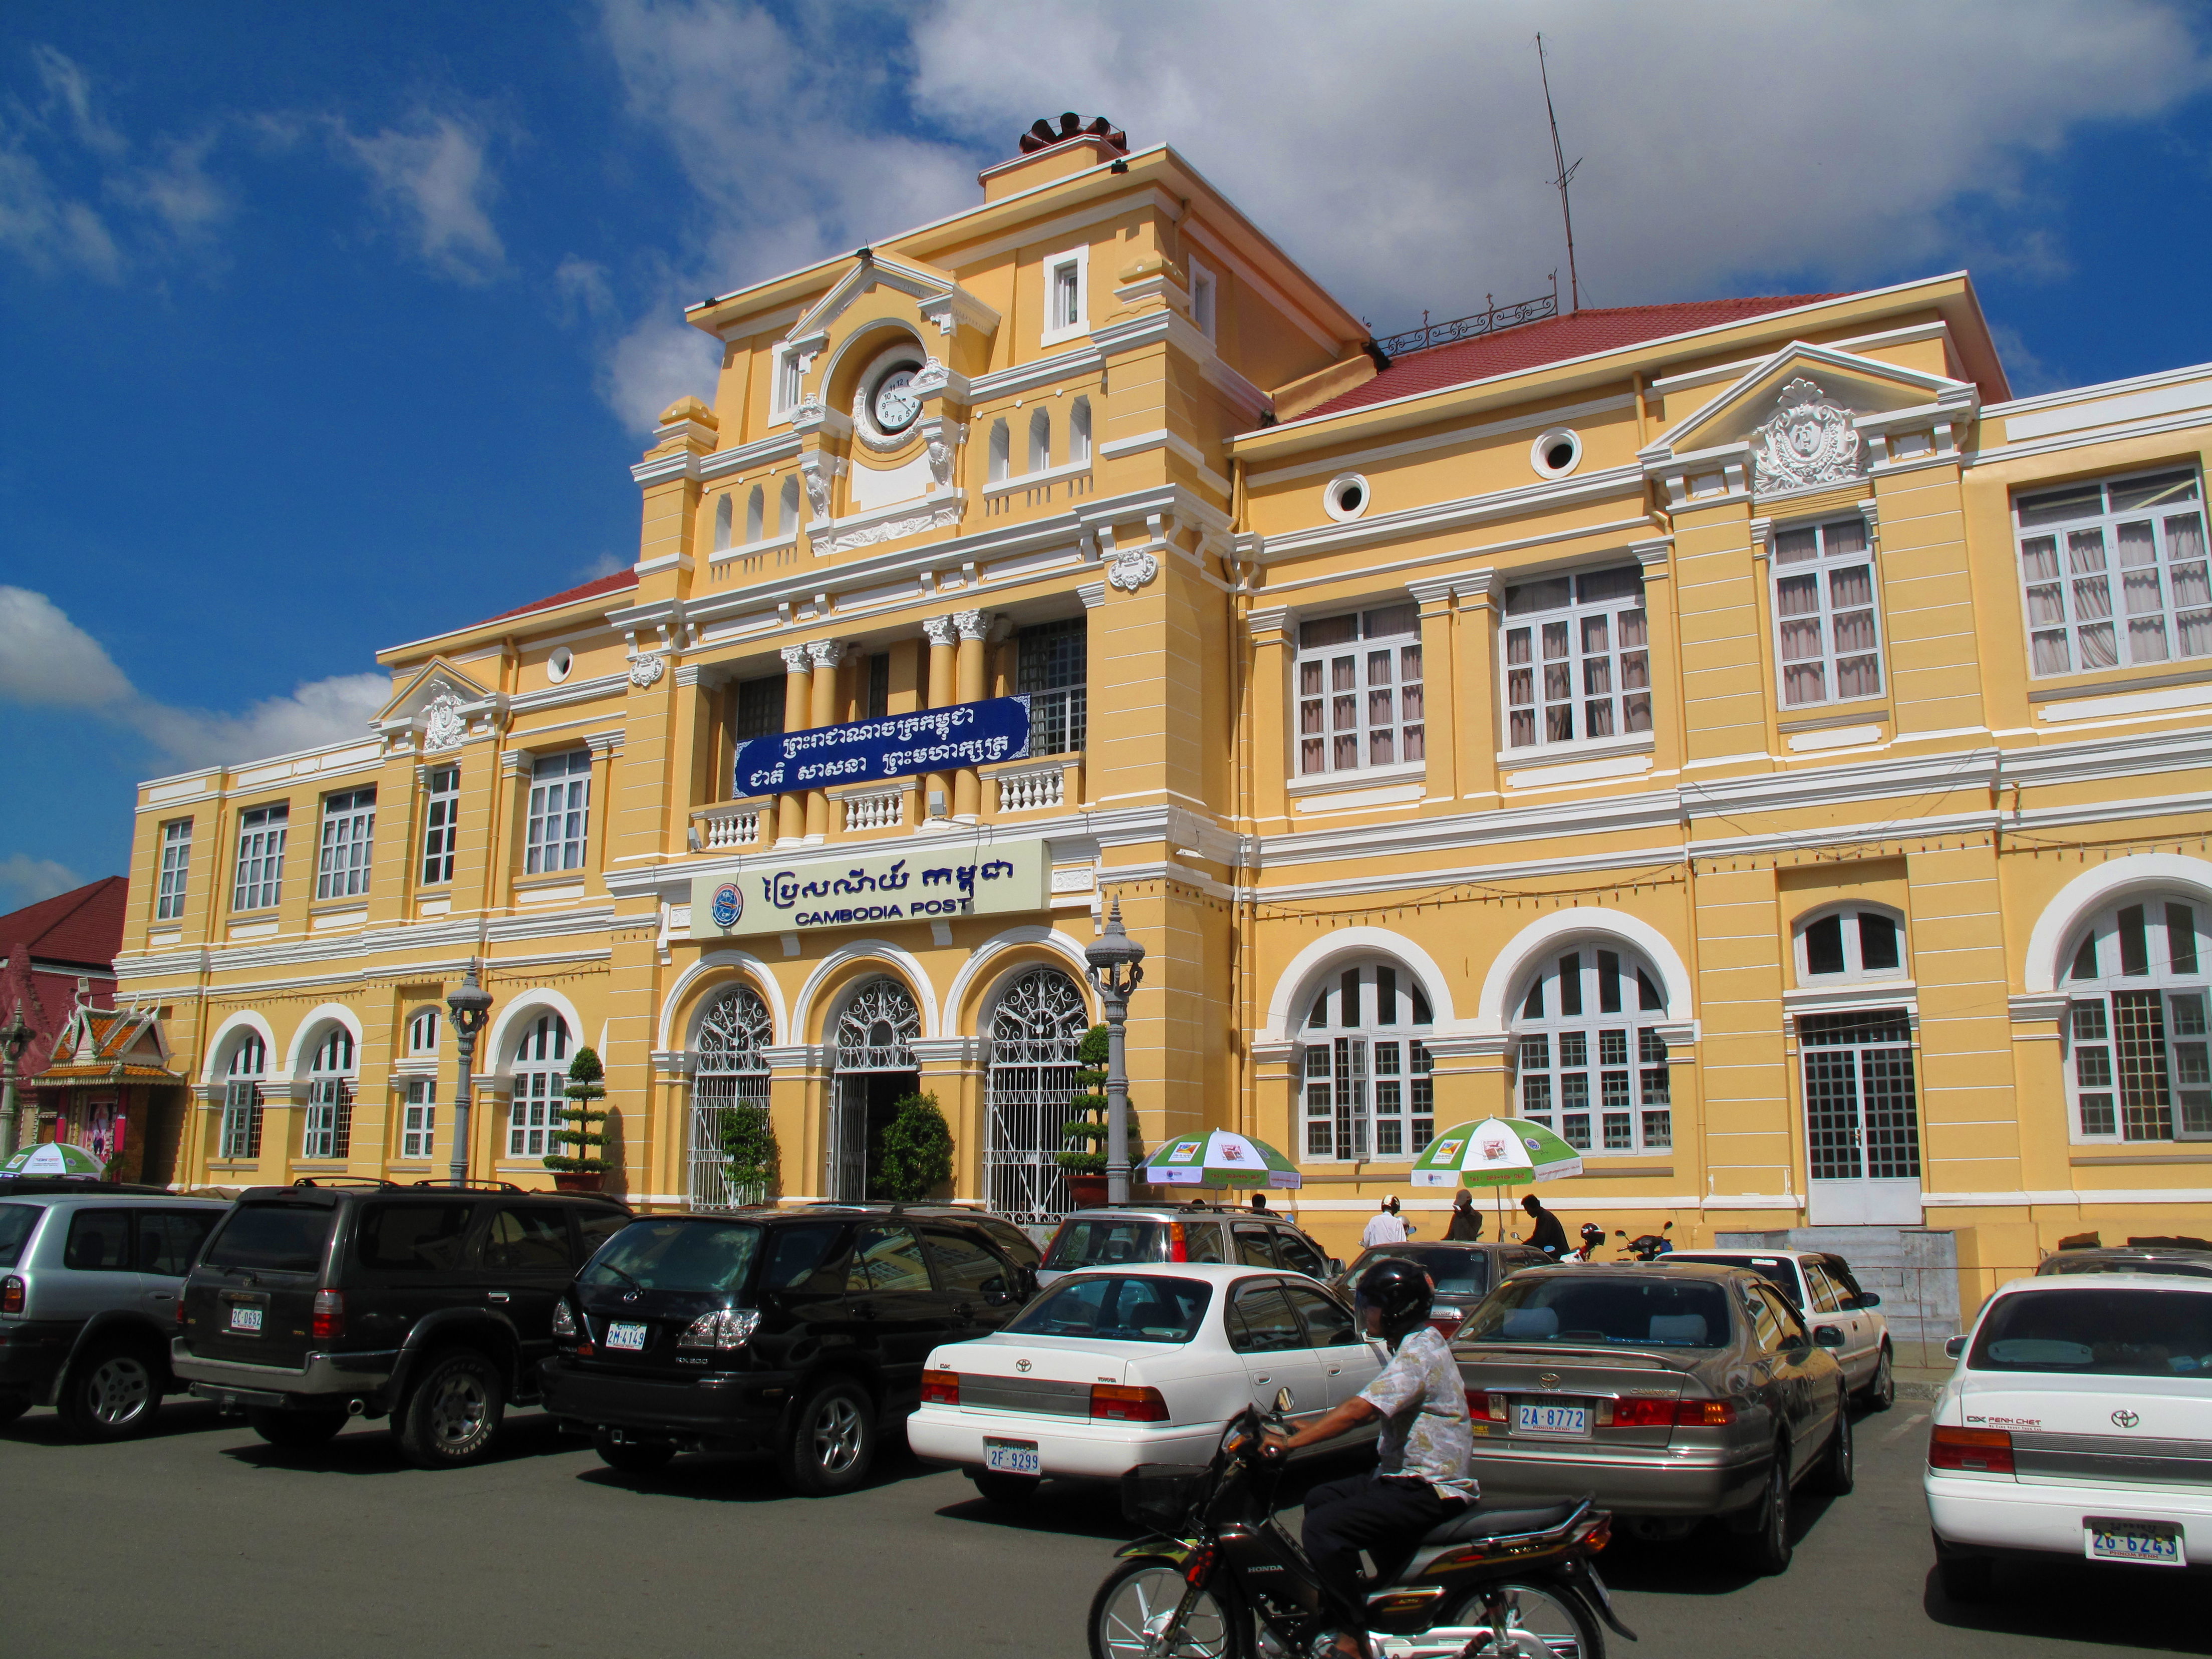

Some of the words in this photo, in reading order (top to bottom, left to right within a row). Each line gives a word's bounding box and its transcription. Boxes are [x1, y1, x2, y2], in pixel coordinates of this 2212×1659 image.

[783, 707, 974, 759] ព្រះរាជាណាចក្រកម្ពុជា
[750, 761, 785, 787] ជាតិ
[797, 757, 867, 780] សាសនា
[882, 735, 1009, 775] ព្រះមហាក្សត្រ
[795, 904, 904, 926] CAMBODIA
[910, 897, 972, 917] POST
[232, 1311, 261, 1325] 2C-0692
[608, 1330, 644, 1345] 2M-4149
[1522, 1408, 1583, 1427] 2A-8772
[992, 1450, 1038, 1469] 2F-9299
[1247, 1565, 1284, 1573] HONDA
